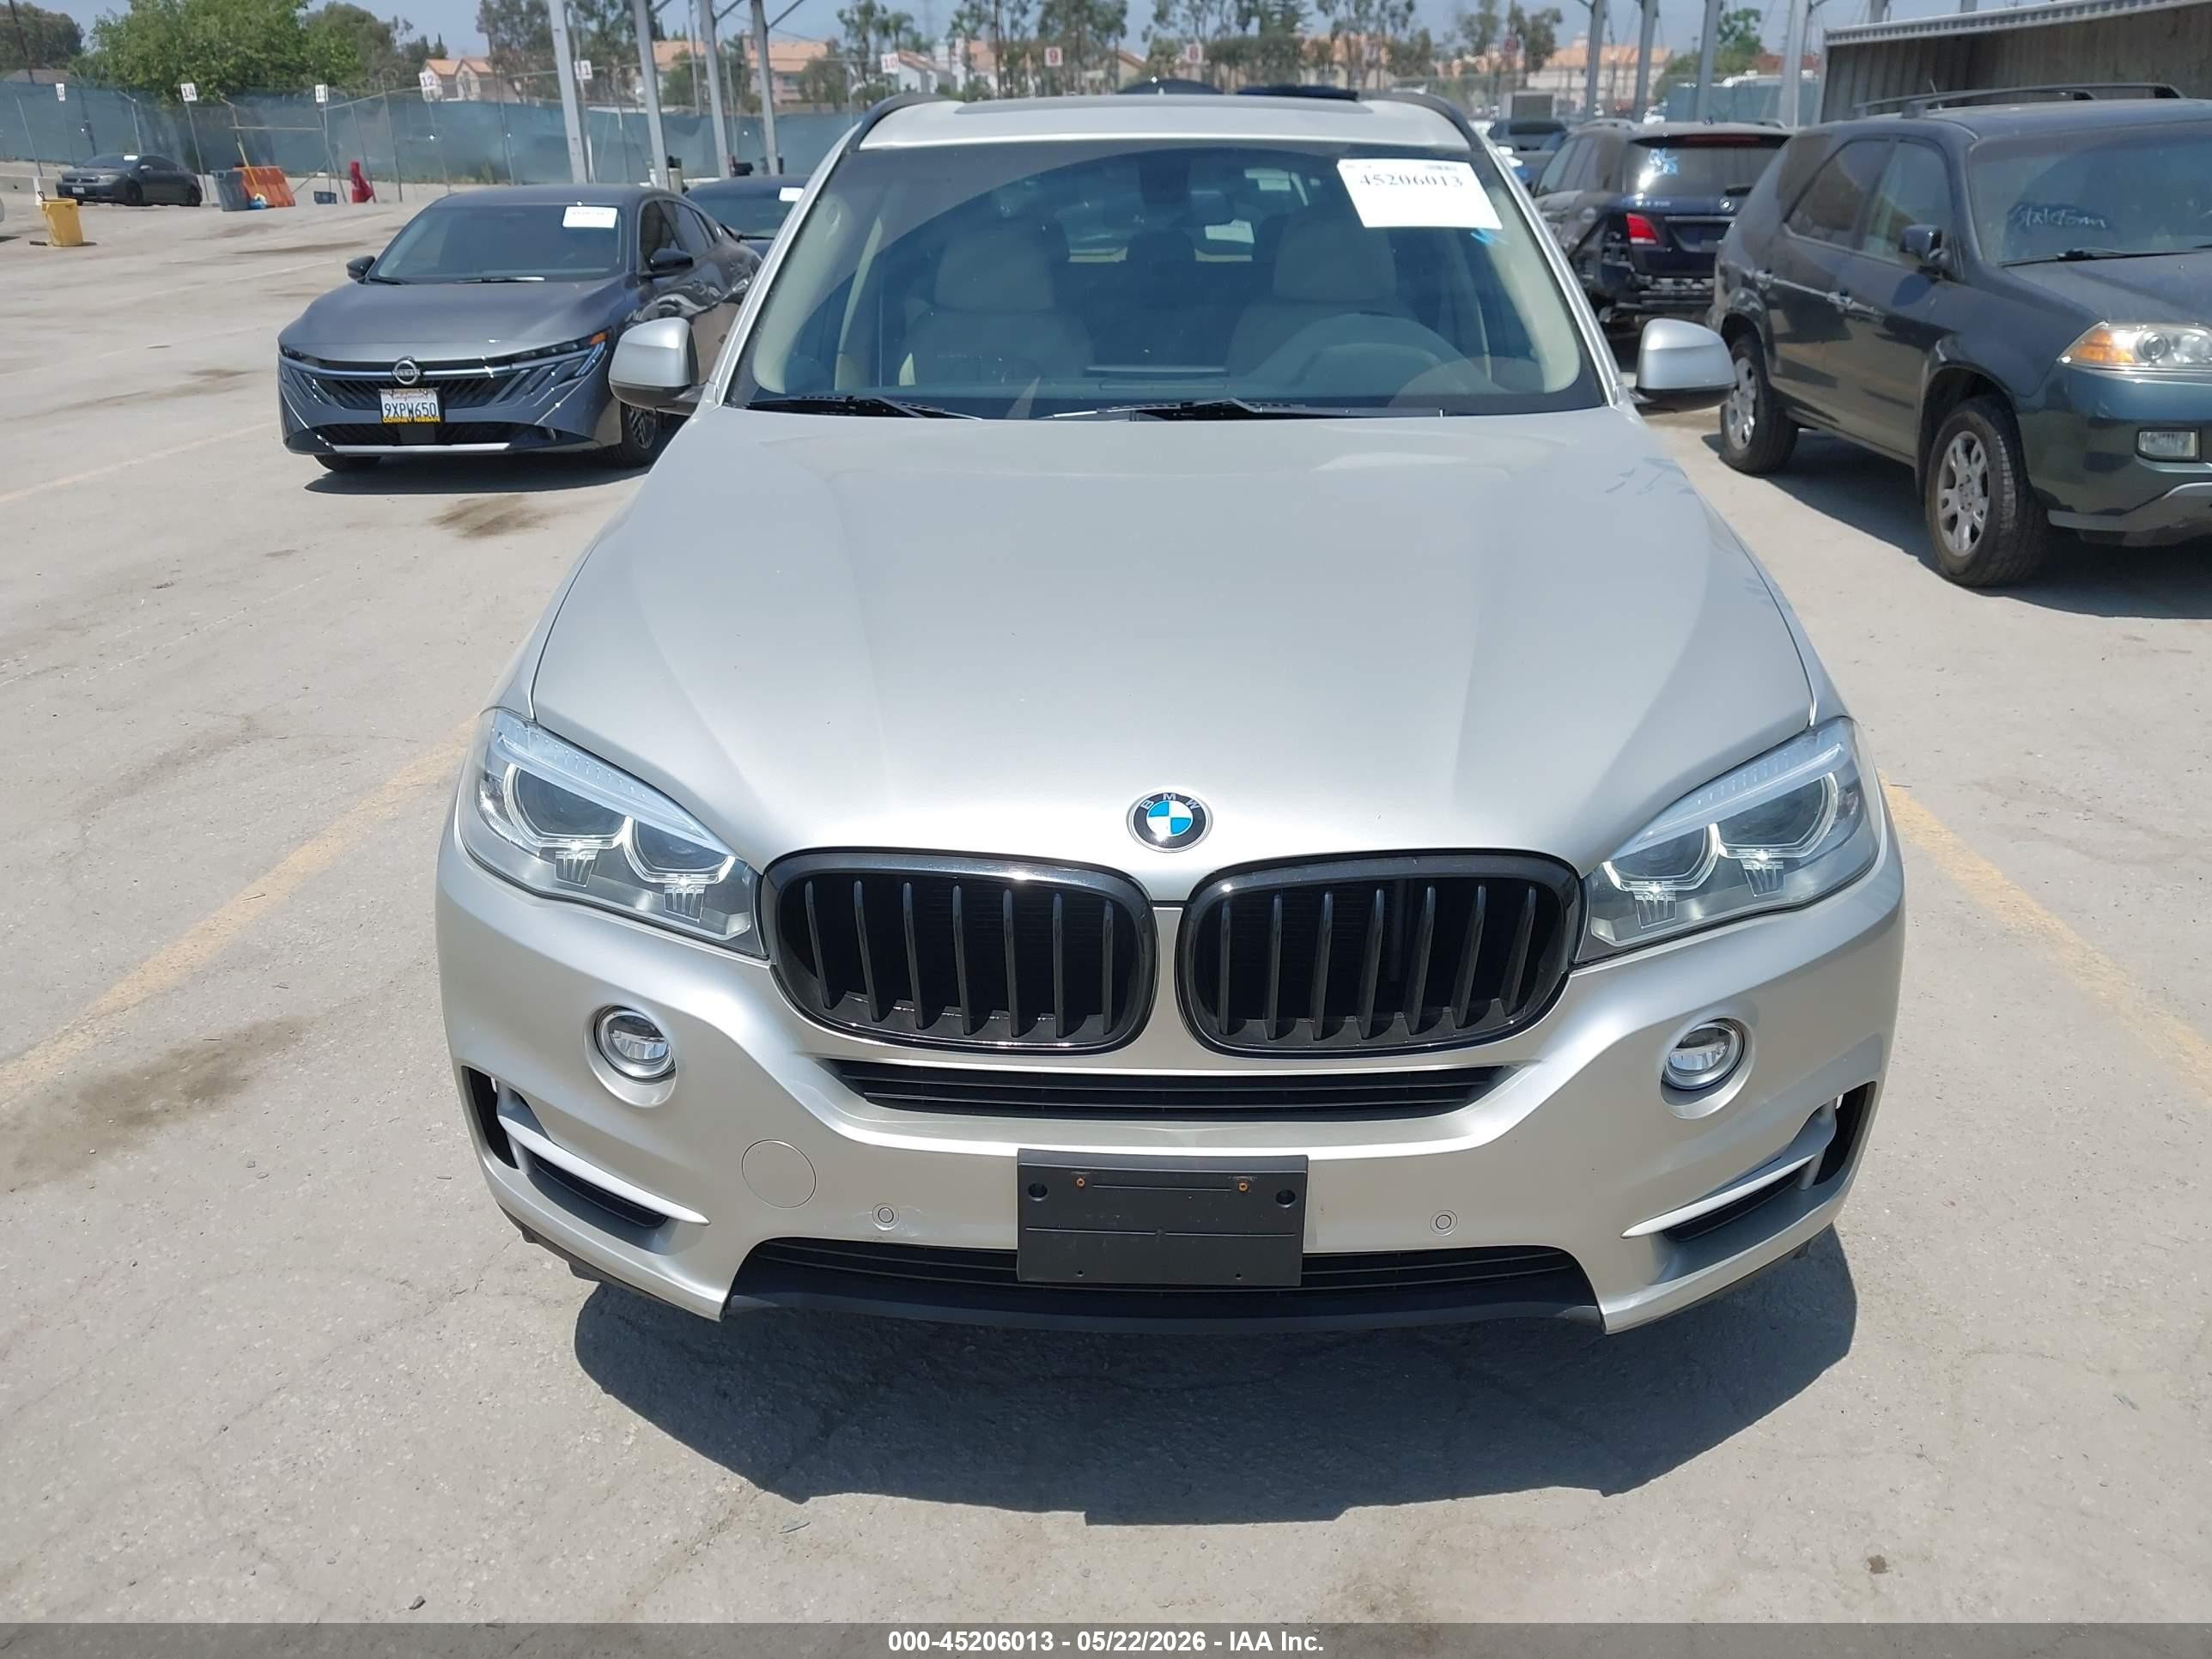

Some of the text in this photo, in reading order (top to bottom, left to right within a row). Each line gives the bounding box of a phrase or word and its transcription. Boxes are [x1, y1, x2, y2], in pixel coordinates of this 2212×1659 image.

[422, 75, 434, 87] 12
[183, 88, 195, 98] 14
[1360, 173, 1463, 187] 45206013
[384, 402, 437, 417] 9XPW650
[1140, 793, 1200, 810] BMW
